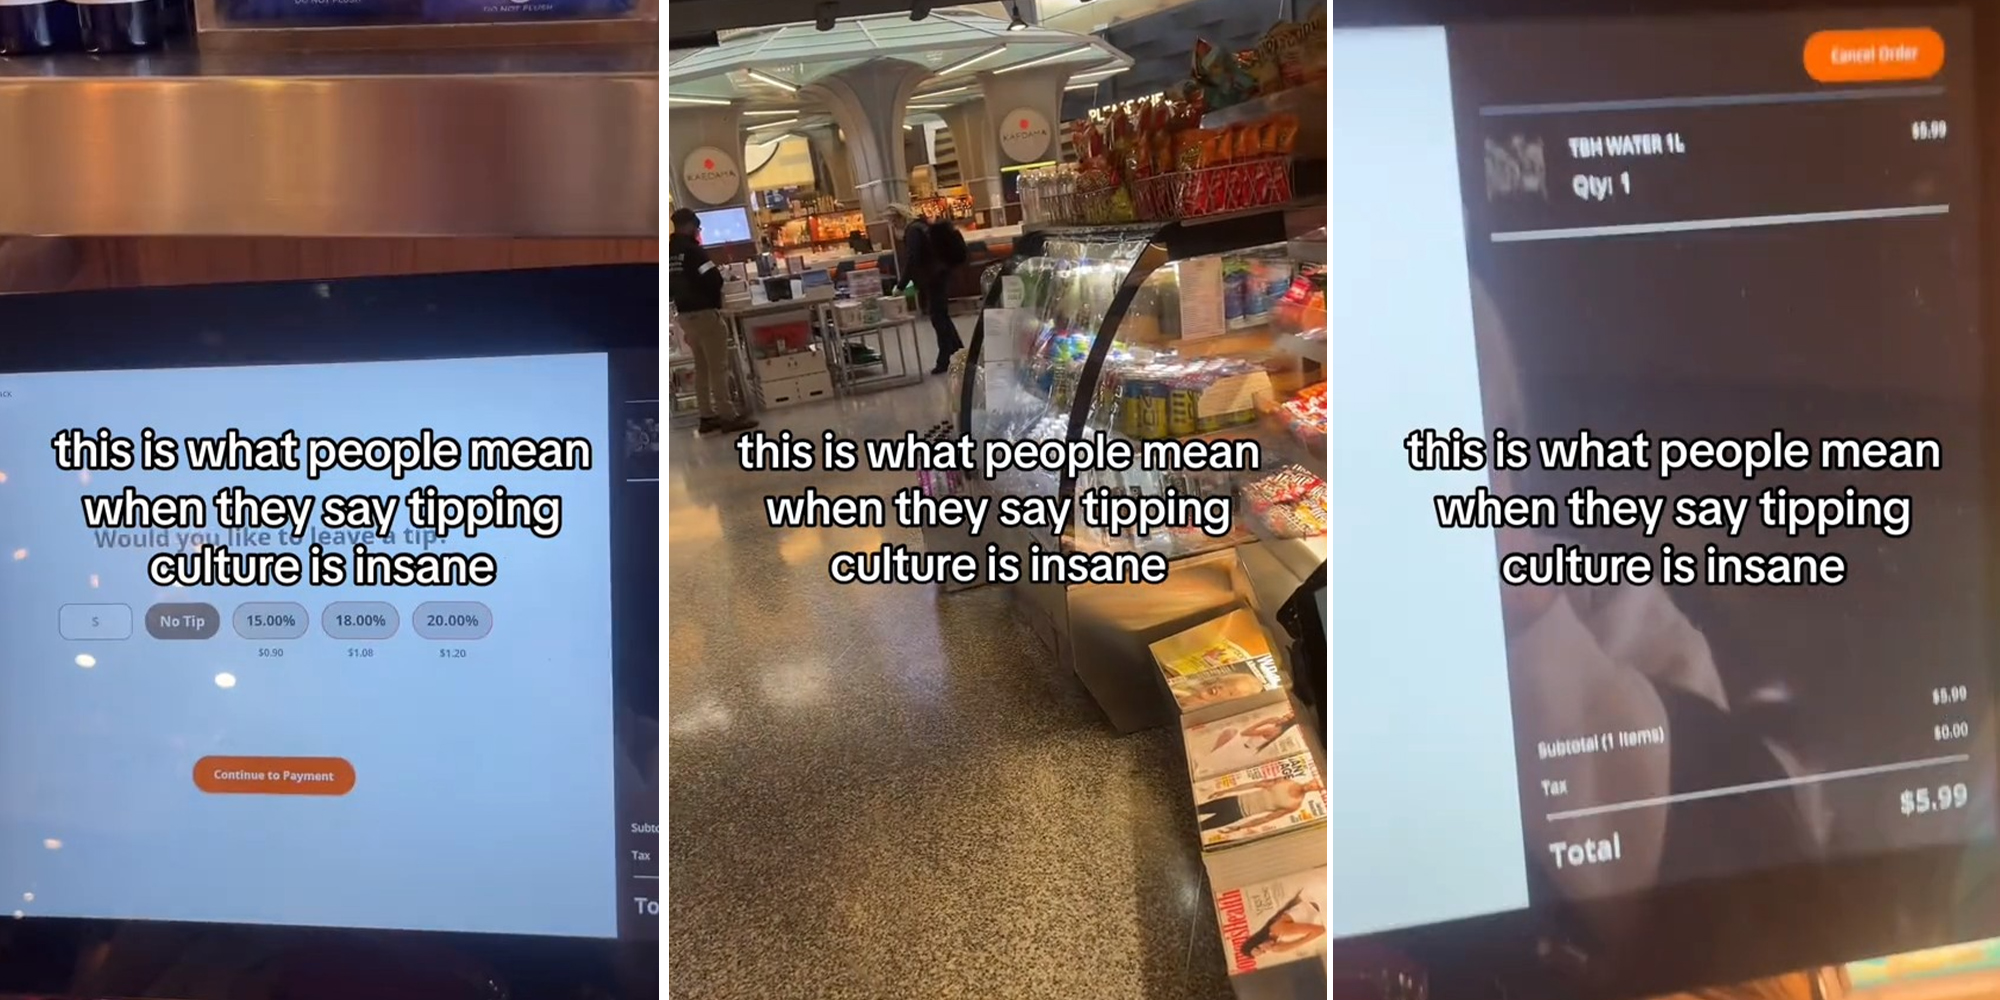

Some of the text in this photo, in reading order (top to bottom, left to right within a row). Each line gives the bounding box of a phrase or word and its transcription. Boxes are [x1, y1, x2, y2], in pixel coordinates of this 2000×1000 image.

[1605, 133, 1663, 157] WATER
[1620, 170, 1631, 195] 1
[94, 528, 170, 549] Would
[227, 526, 272, 547] like
[311, 526, 375, 546] leave
[160, 614, 206, 630] No Tip
[246, 614, 297, 627] 15.00%
[335, 614, 386, 627] 18.00%
[427, 614, 479, 627] 20.00%
[258, 648, 284, 658] $0.90
[348, 648, 374, 658] $1.08
[440, 648, 466, 658] $1.20
[1537, 734, 1600, 760] Subtotal
[213, 769, 335, 784] Continue to Payment
[1541, 779, 1568, 797] Tax
[1900, 782, 1968, 818] $5.99
[631, 850, 651, 861] Tax
[1549, 830, 1622, 870] Total
[633, 897, 659, 915] To
